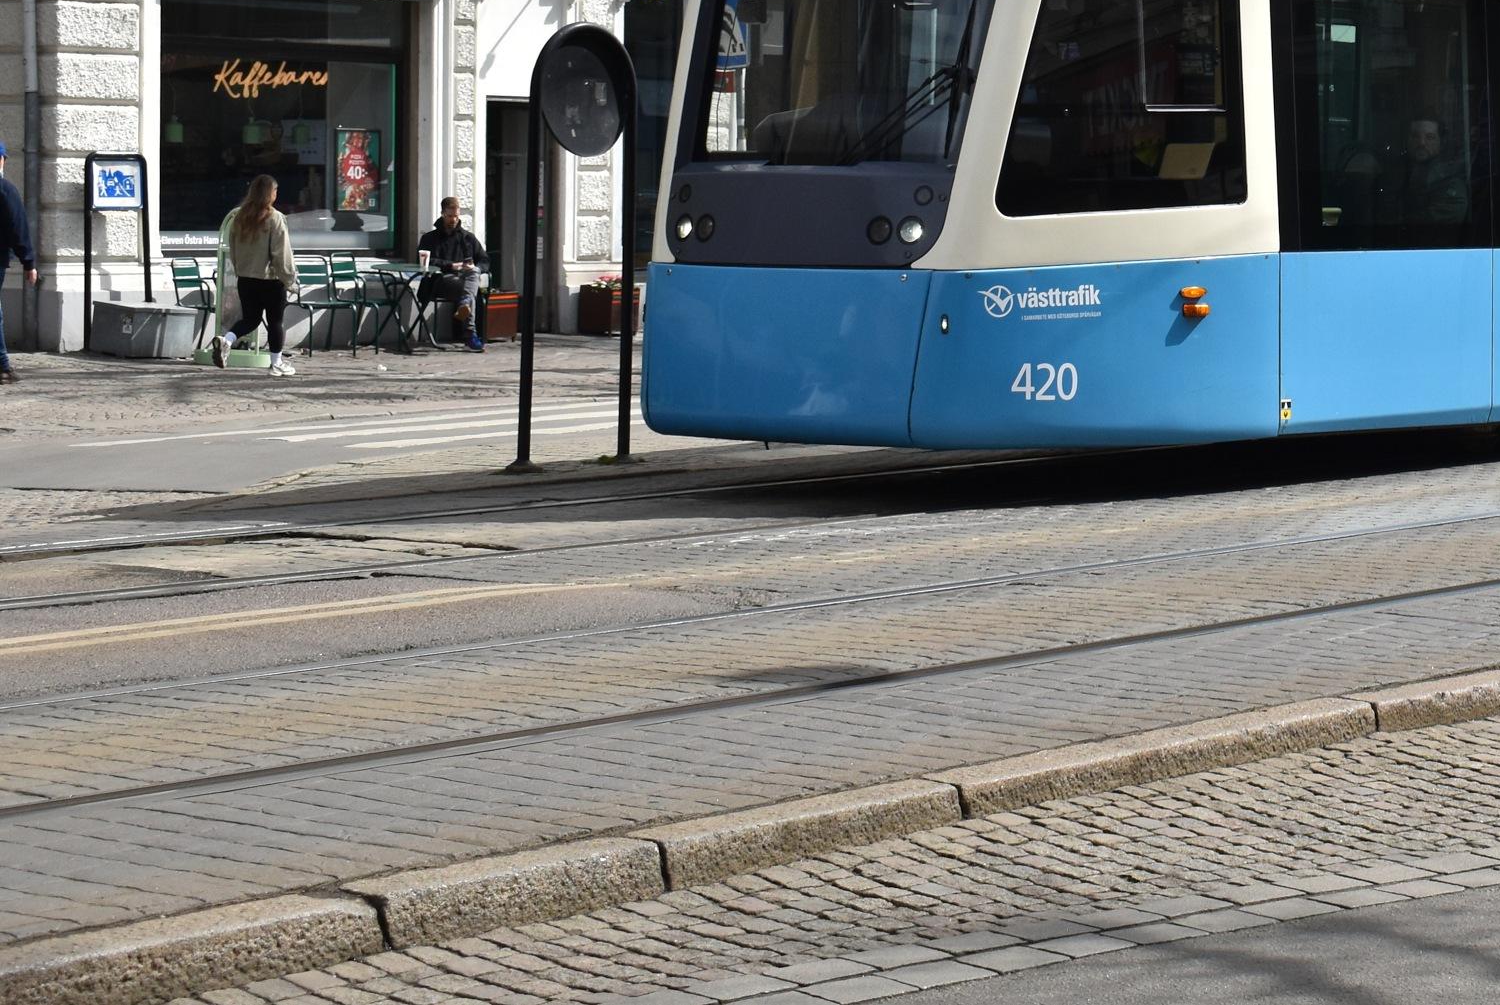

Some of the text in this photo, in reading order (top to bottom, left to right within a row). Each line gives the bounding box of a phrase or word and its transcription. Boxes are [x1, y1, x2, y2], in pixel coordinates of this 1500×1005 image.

[184, 234, 202, 245] Östra
[1017, 284, 1101, 309] västtrafik
[1011, 363, 1078, 401] 420
